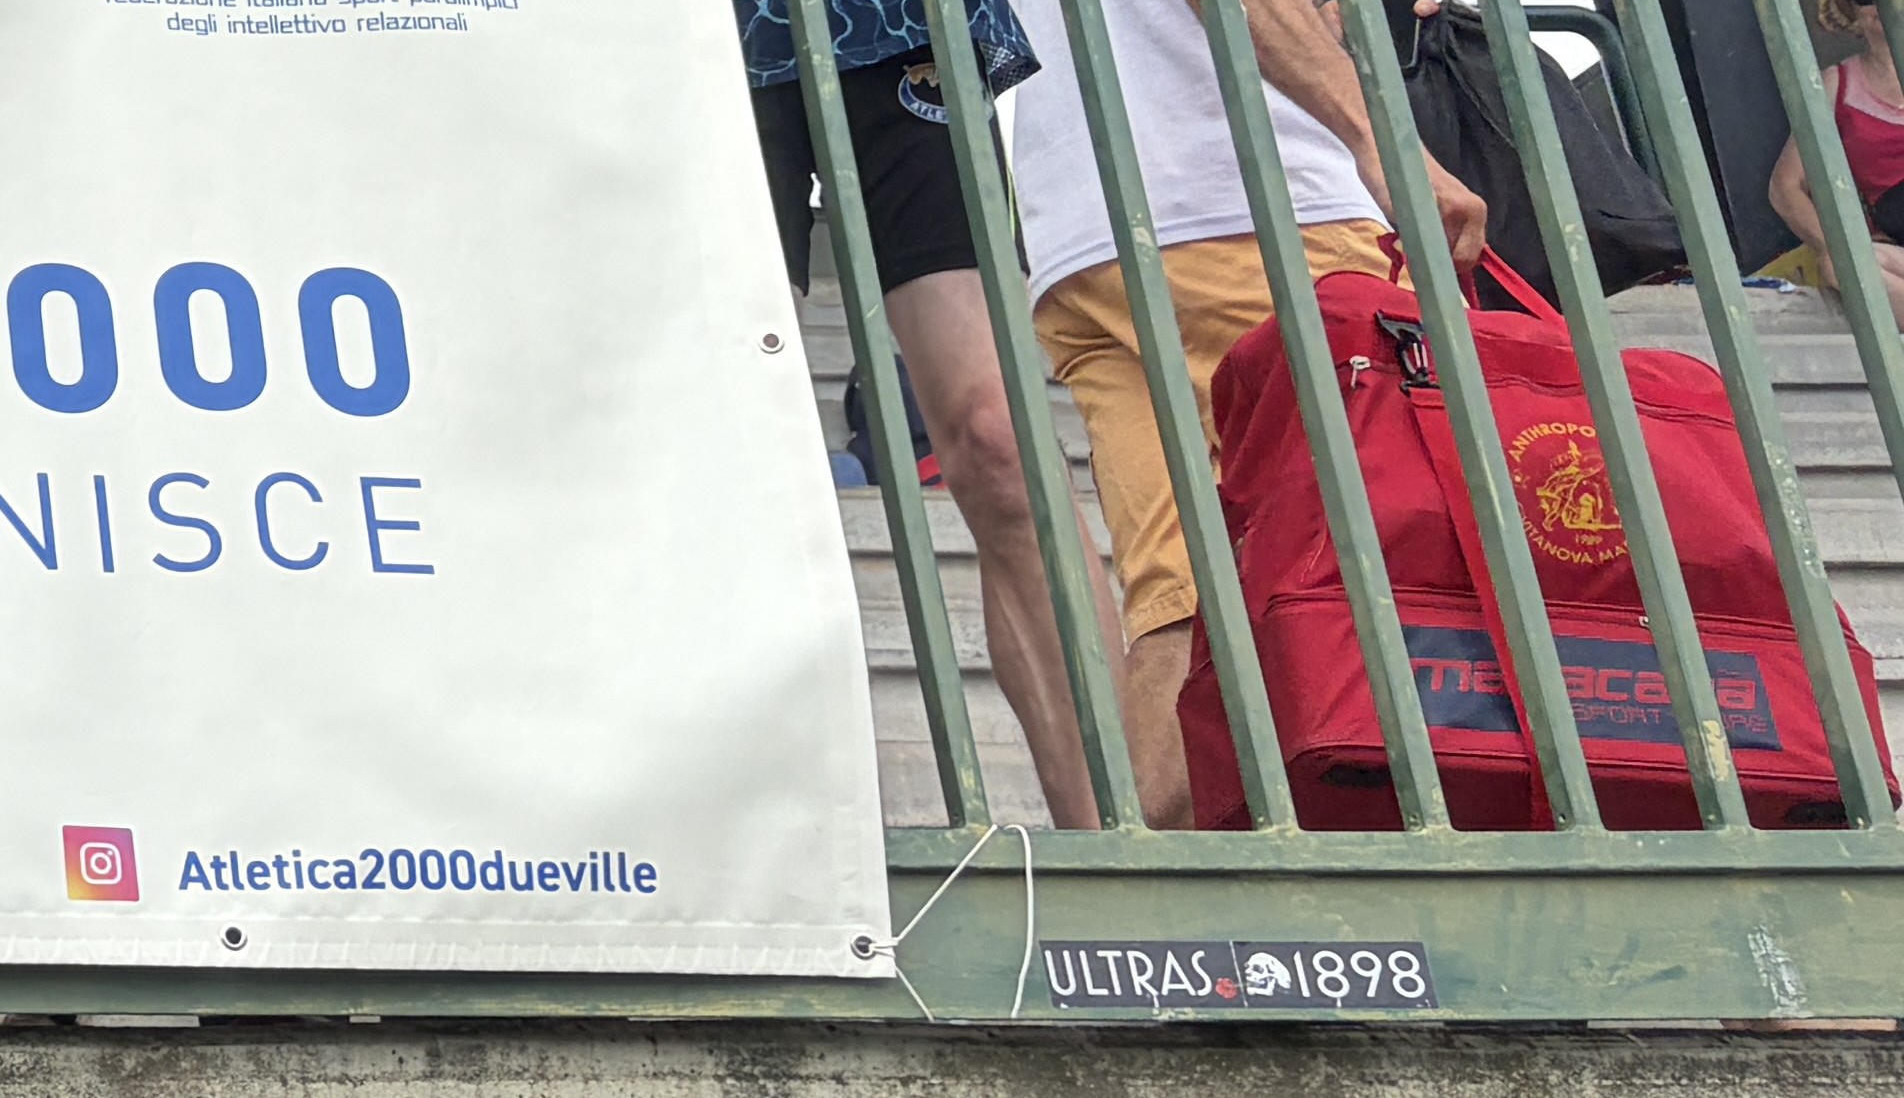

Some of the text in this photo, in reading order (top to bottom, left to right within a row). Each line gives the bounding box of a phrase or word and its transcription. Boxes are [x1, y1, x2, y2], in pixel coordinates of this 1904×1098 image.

[166, 12, 469, 37] degli intellettivo relazionali
[1509, 422, 1596, 463] ANTHROPO
[177, 847, 659, 894] Atletica2000dueville
[1043, 949, 1427, 999] ULTRAS 1898
